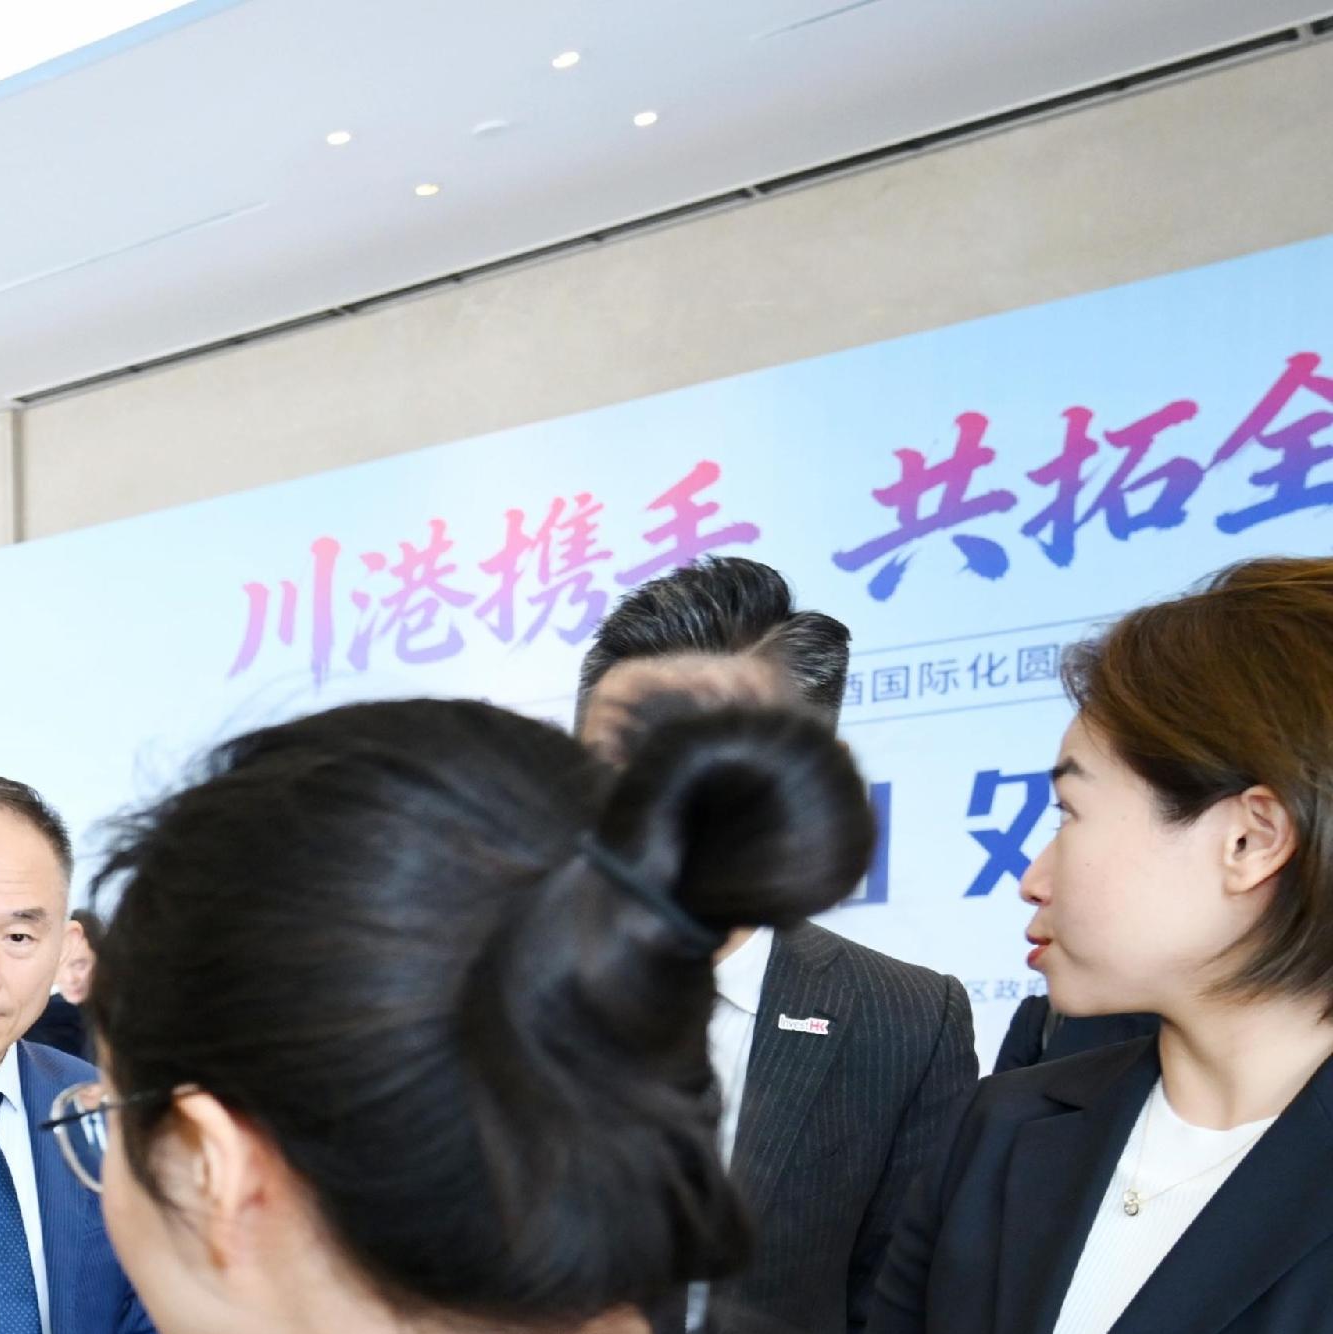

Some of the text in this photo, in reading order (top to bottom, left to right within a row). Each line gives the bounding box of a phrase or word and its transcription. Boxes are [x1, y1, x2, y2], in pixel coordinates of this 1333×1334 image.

[228, 351, 1333, 688] 川港携手 共拓全
